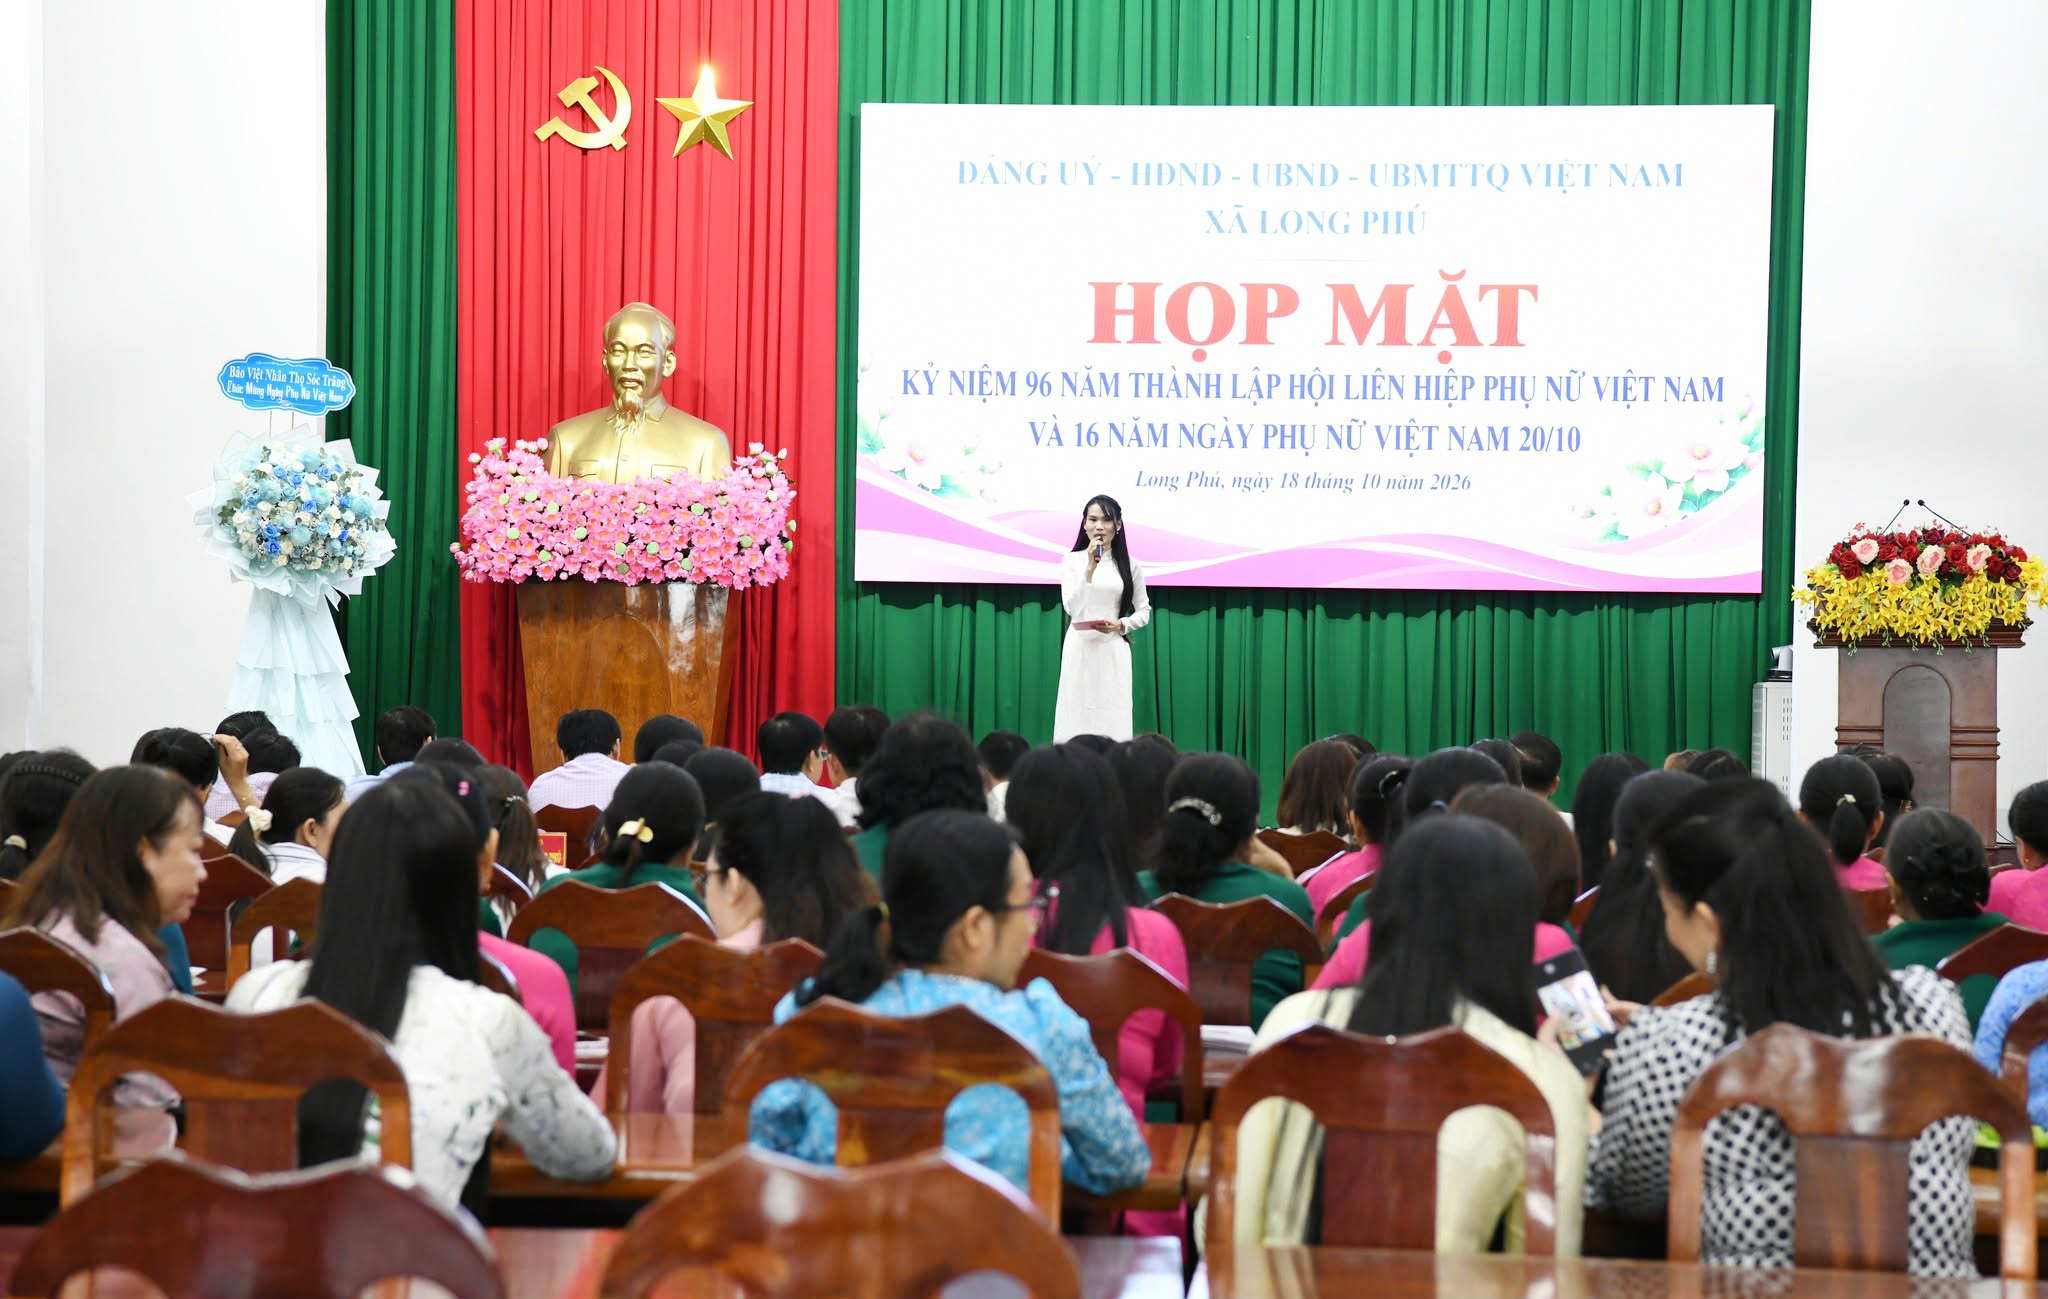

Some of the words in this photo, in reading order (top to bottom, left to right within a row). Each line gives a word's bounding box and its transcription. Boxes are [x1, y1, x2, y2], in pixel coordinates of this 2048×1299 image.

[1131, 162, 1222, 187] HĐND
[1252, 162, 1340, 188] UBND
[1368, 163, 1510, 193] UBMTTQ
[1519, 159, 1598, 195] VIỆT
[1608, 163, 1684, 188] NAM
[1205, 204, 1248, 235] XÃ
[1259, 209, 1350, 235] LONG
[1362, 203, 1426, 236] PHÚ
[1087, 281, 1300, 363] HỌP
[1324, 269, 1539, 365] MẶT
[229, 366, 245, 378] Bảo
[247, 367, 264, 383] Việt
[265, 368, 287, 383] Nhân
[289, 371, 305, 386] Thọ
[306, 372, 321, 386] Sóc
[323, 374, 346, 391] Trăng
[285, 385, 300, 401] Phụ
[328, 389, 344, 403] Nam
[902, 361, 940, 396] KỶ
[949, 364, 1017, 404] NIỆM
[1025, 371, 1053, 398] 96
[1061, 365, 1121, 399] NĂM
[1129, 365, 1222, 399] THÀNH
[1231, 367, 1281, 406] LẬP
[1288, 367, 1336, 407] HỘI
[1344, 367, 1406, 401] LIÊN
[1414, 368, 1475, 409] HIỆP
[1483, 375, 1537, 409] PHỤ
[1545, 369, 1586, 402] NỮ
[1592, 369, 1656, 410] VIỆT
[1663, 376, 1725, 403] NAM
[1028, 414, 1064, 448] VÀ
[1075, 421, 1099, 449] 16
[1108, 416, 1169, 449] NĂM
[1178, 416, 1254, 450] NGÀY
[1263, 424, 1317, 457] PHỤ
[1325, 418, 1368, 451] NỮ
[1374, 418, 1440, 459] VIỆT
[1447, 425, 1511, 452] NAM
[1518, 426, 1582, 453] 20/10
[1135, 470, 1180, 493] Long
[1186, 470, 1225, 489] Phú,
[1231, 471, 1273, 493] ngày
[1280, 472, 1300, 489] 18
[1304, 472, 1355, 495] tháng
[1361, 472, 1382, 490] 10
[1386, 473, 1424, 490] năm
[1430, 473, 1471, 491] 2026
